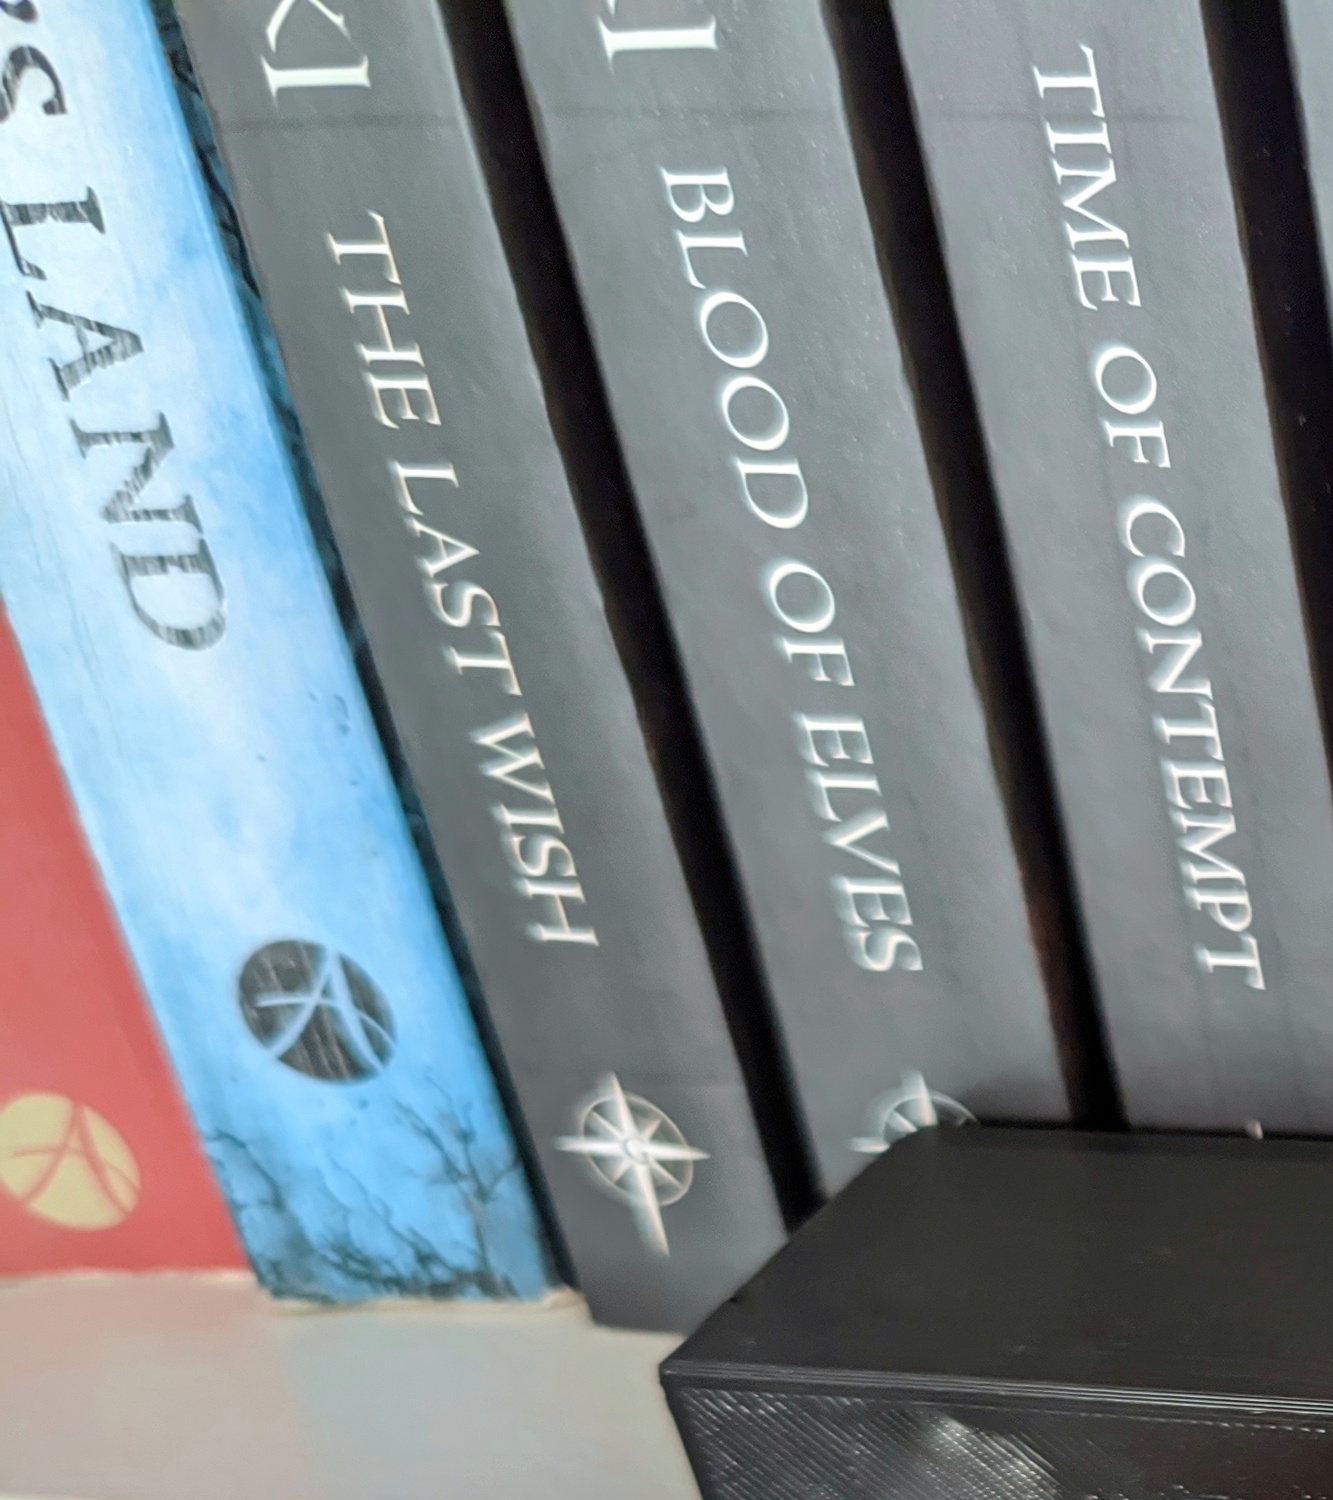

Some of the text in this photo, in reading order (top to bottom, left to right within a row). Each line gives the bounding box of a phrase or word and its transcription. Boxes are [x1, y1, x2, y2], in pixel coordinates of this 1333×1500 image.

[1, 184, 229, 652] LAND
[328, 210, 599, 948] THE LAST WISH
[659, 164, 923, 973] BLOOD OF ELVES
[1033, 41, 1266, 990] TIME OF CONTEMPT
